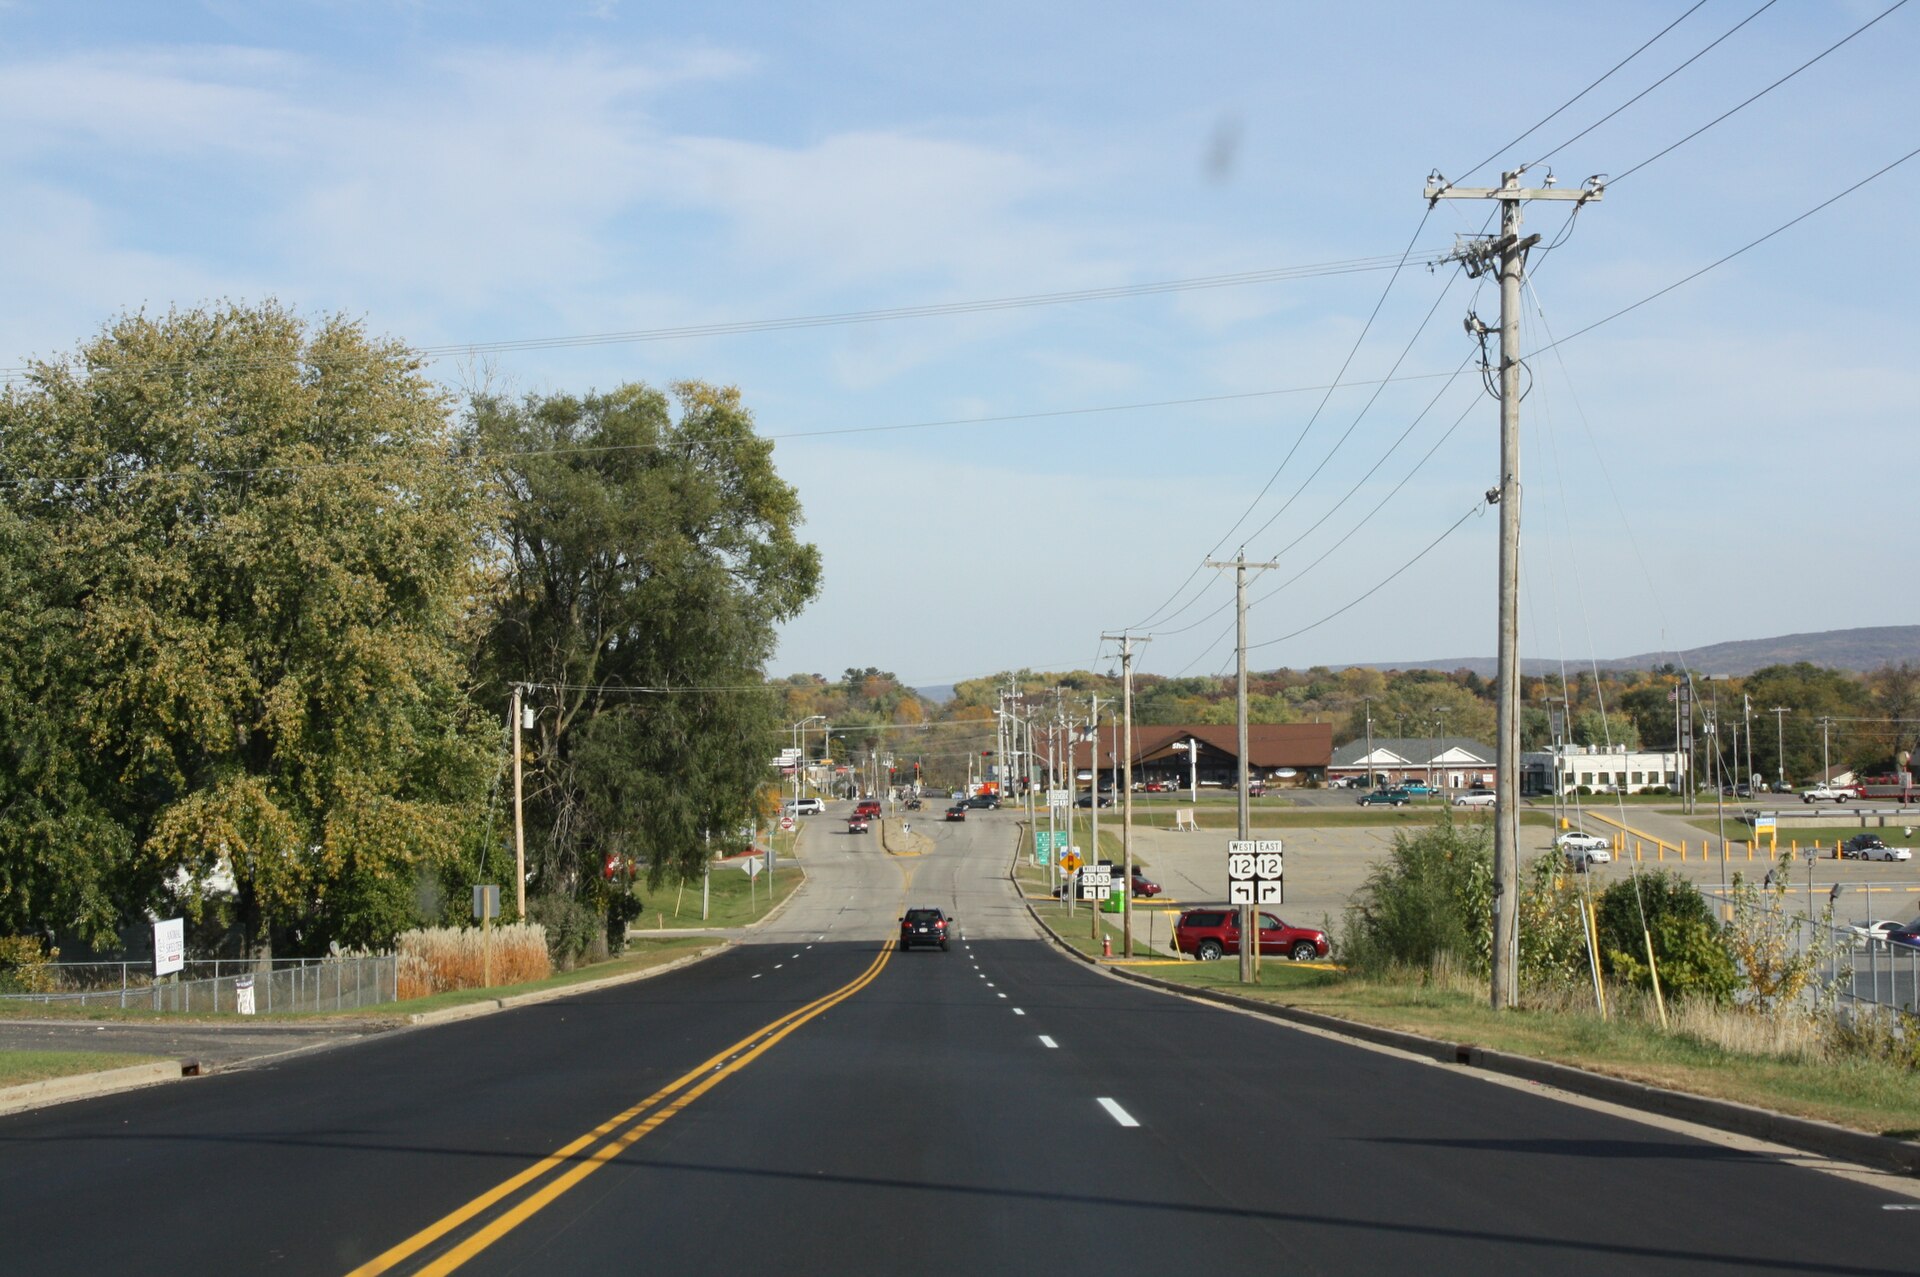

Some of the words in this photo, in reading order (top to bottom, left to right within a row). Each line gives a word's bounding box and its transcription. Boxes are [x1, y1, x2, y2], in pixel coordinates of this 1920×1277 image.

[1231, 843, 1252, 851] WEST
[1260, 842, 1279, 851] EAST
[1234, 860, 1251, 873] 12
[1261, 859, 1278, 873] 12
[1084, 875, 1095, 883] 33
[1098, 875, 1109, 883] 33
